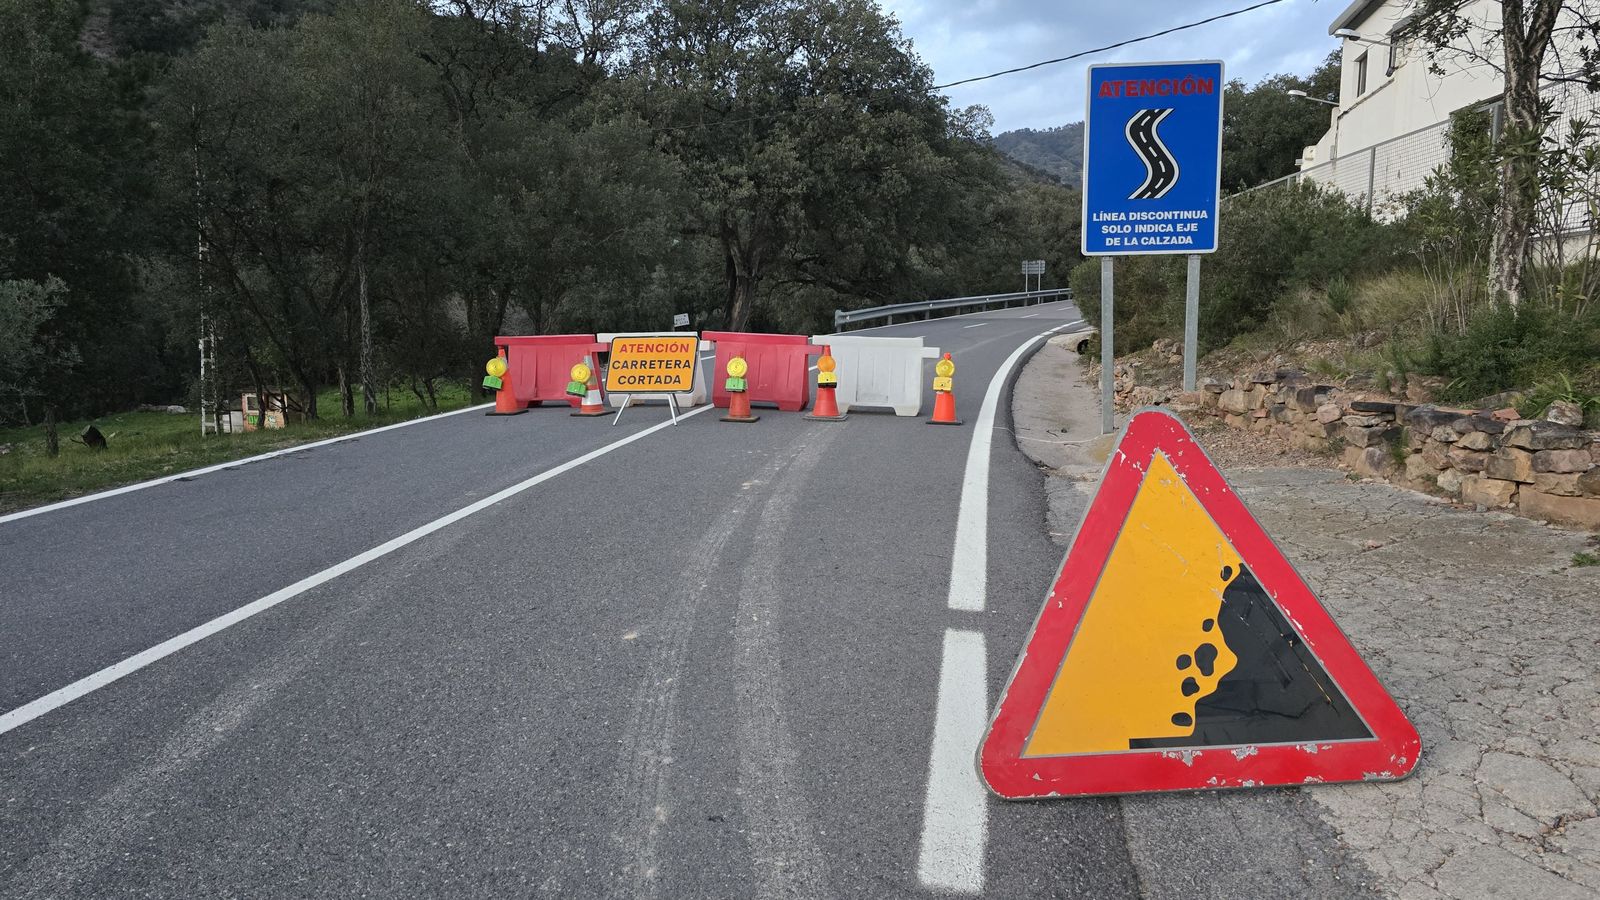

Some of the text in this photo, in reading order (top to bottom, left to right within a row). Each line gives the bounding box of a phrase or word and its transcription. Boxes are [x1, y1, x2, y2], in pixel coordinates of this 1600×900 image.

[1098, 74, 1213, 97] ATENCIÓN
[1092, 210, 1208, 222] LÍNEA DISCONTINUA
[1101, 223, 1198, 234] SOLO INDICA EJE
[1105, 236, 1193, 246] DE LA CALZADA
[619, 341, 689, 353] ATENCIÓN
[612, 359, 691, 370] CARRETERA
[617, 375, 681, 385] CORTADA
